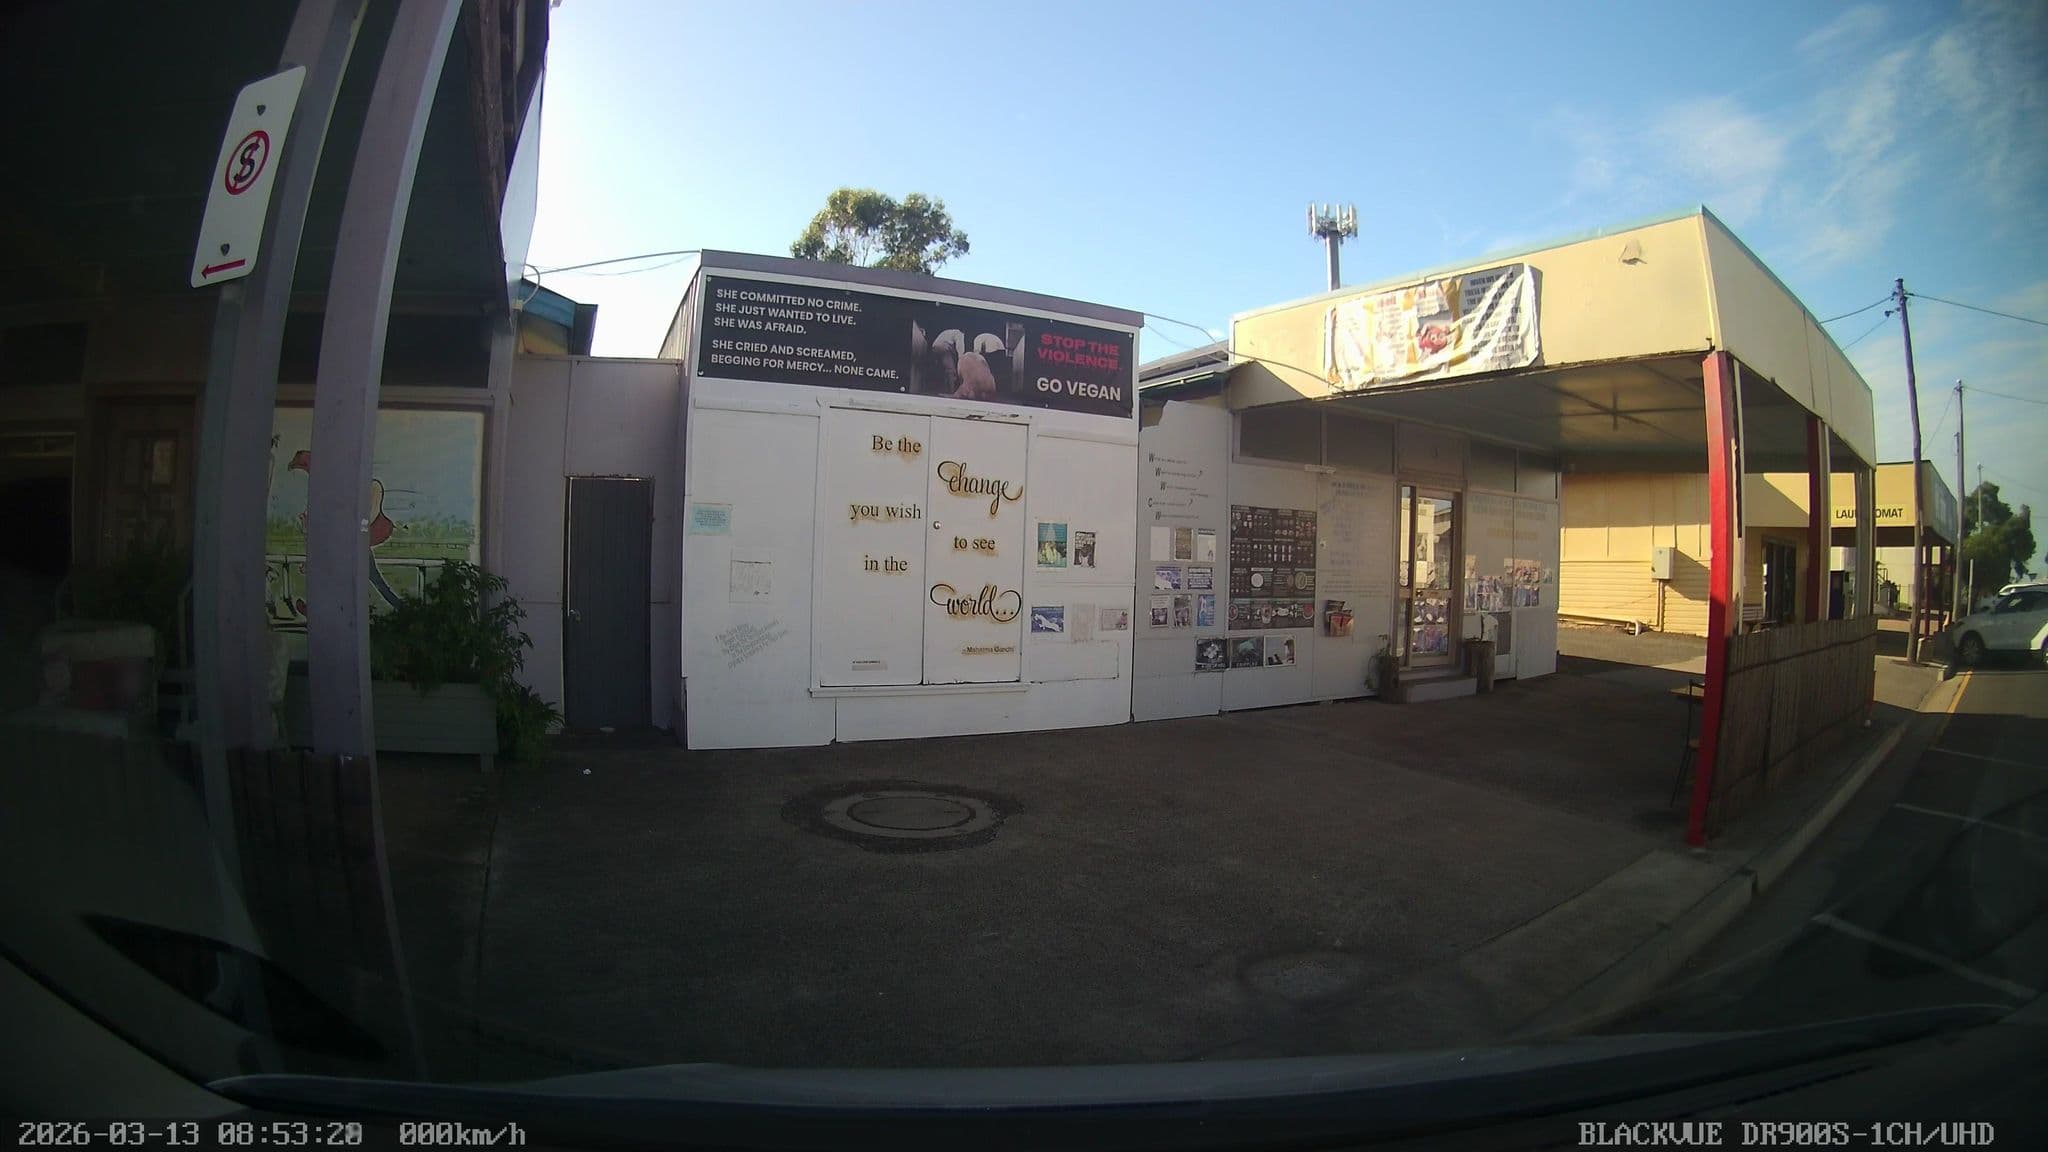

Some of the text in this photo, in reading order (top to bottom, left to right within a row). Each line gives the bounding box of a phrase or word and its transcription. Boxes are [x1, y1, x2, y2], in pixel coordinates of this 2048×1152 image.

[717, 289, 862, 313] SHE COMMITTED NO CRIME.
[715, 303, 857, 326] SHE JUST WANTED TO LIVE.
[714, 317, 807, 335] SHE WAS AFRAID.
[712, 339, 857, 363] SHE CRIED AND SCREAMED,
[1041, 334, 1119, 355] STOP THE
[711, 354, 899, 380] BEGGING FOR MERCY... NONE CAME.
[1037, 348, 1122, 370] VIOLENCE.
[1037, 377, 1121, 401] GO VEGAN
[872, 435, 922, 453] Be the
[937, 460, 1023, 515] change
[850, 503, 922, 520] you wish
[1836, 508, 1903, 519] LAUOMAT
[954, 536, 996, 550] to see
[864, 555, 908, 572] in the
